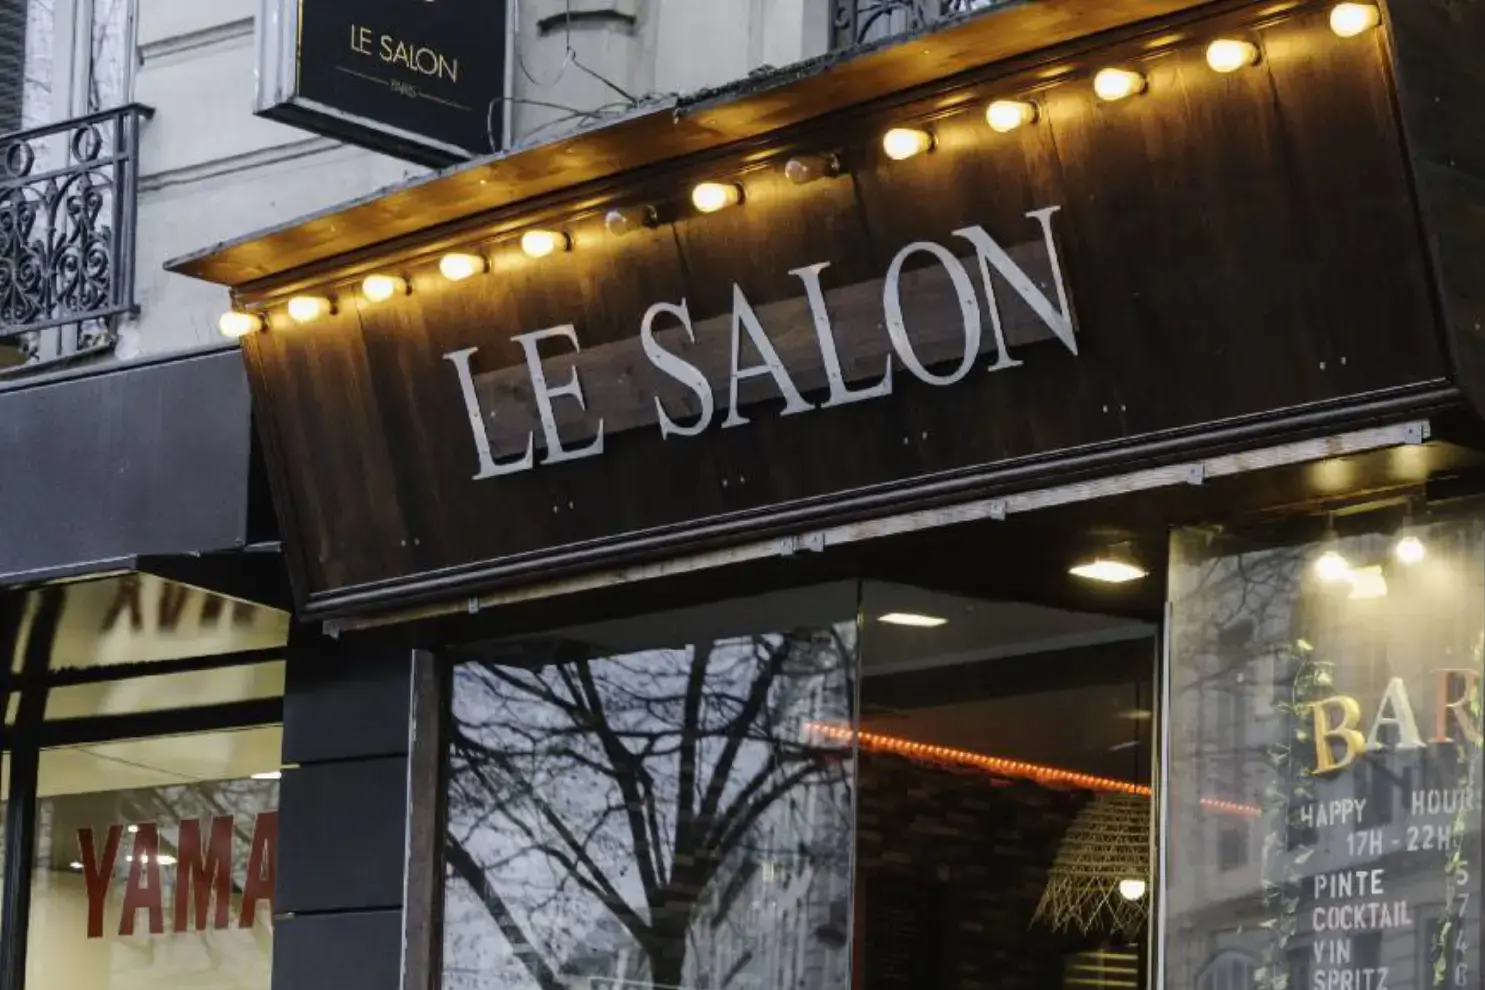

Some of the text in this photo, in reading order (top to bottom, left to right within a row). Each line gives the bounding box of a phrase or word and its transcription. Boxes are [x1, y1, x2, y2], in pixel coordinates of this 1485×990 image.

[350, 23, 458, 83] LE SALON
[443, 205, 1080, 481] LE SALON
[1305, 668, 1483, 775] BAR
[1301, 798, 1367, 828] HAPPY
[1347, 829, 1383, 856] 17H
[1314, 868, 1385, 899] PINTE
[1312, 900, 1413, 932] COCKTAIL
[1313, 939, 1351, 965] VIN
